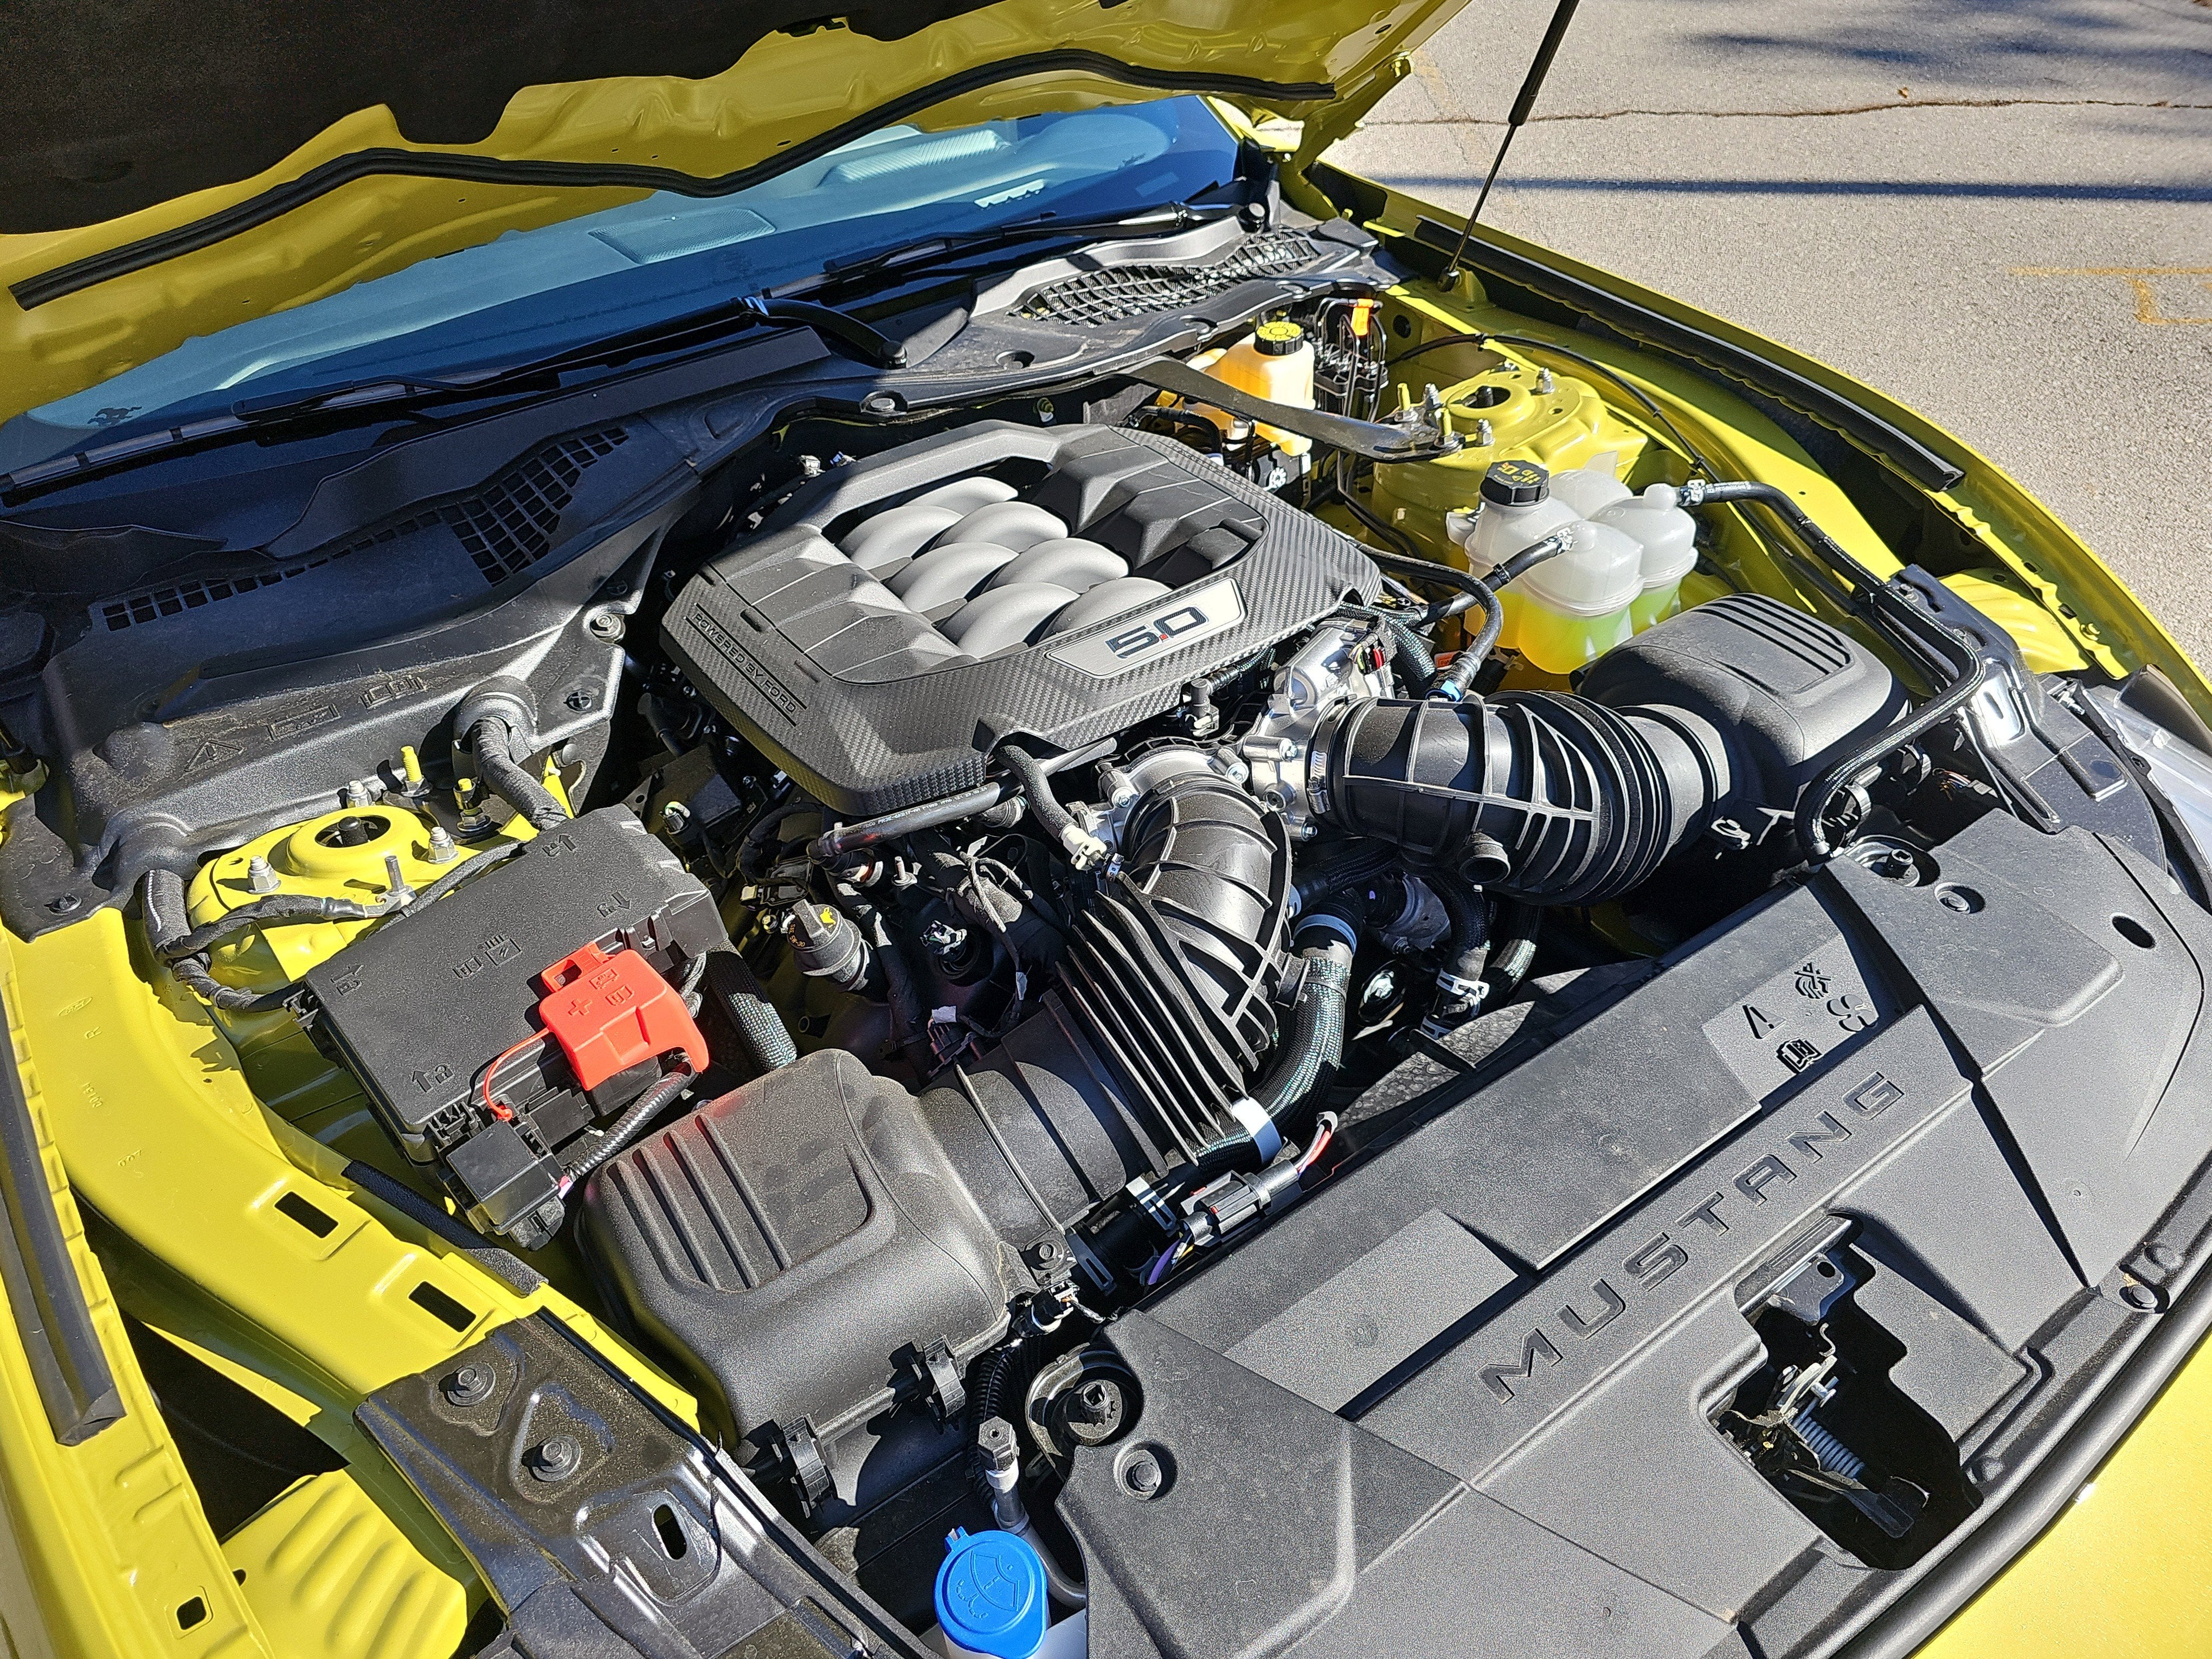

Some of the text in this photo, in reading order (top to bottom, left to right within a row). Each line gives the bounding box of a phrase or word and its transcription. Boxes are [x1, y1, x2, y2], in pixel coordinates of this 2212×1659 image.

[1105, 606, 1210, 659] 5.0
[693, 613, 796, 713] POWERED BY FORD
[789, 935, 806, 947] 5W-30
[84, 1026, 103, 1039] R
[1478, 1071, 1905, 1405] MUSTANG
